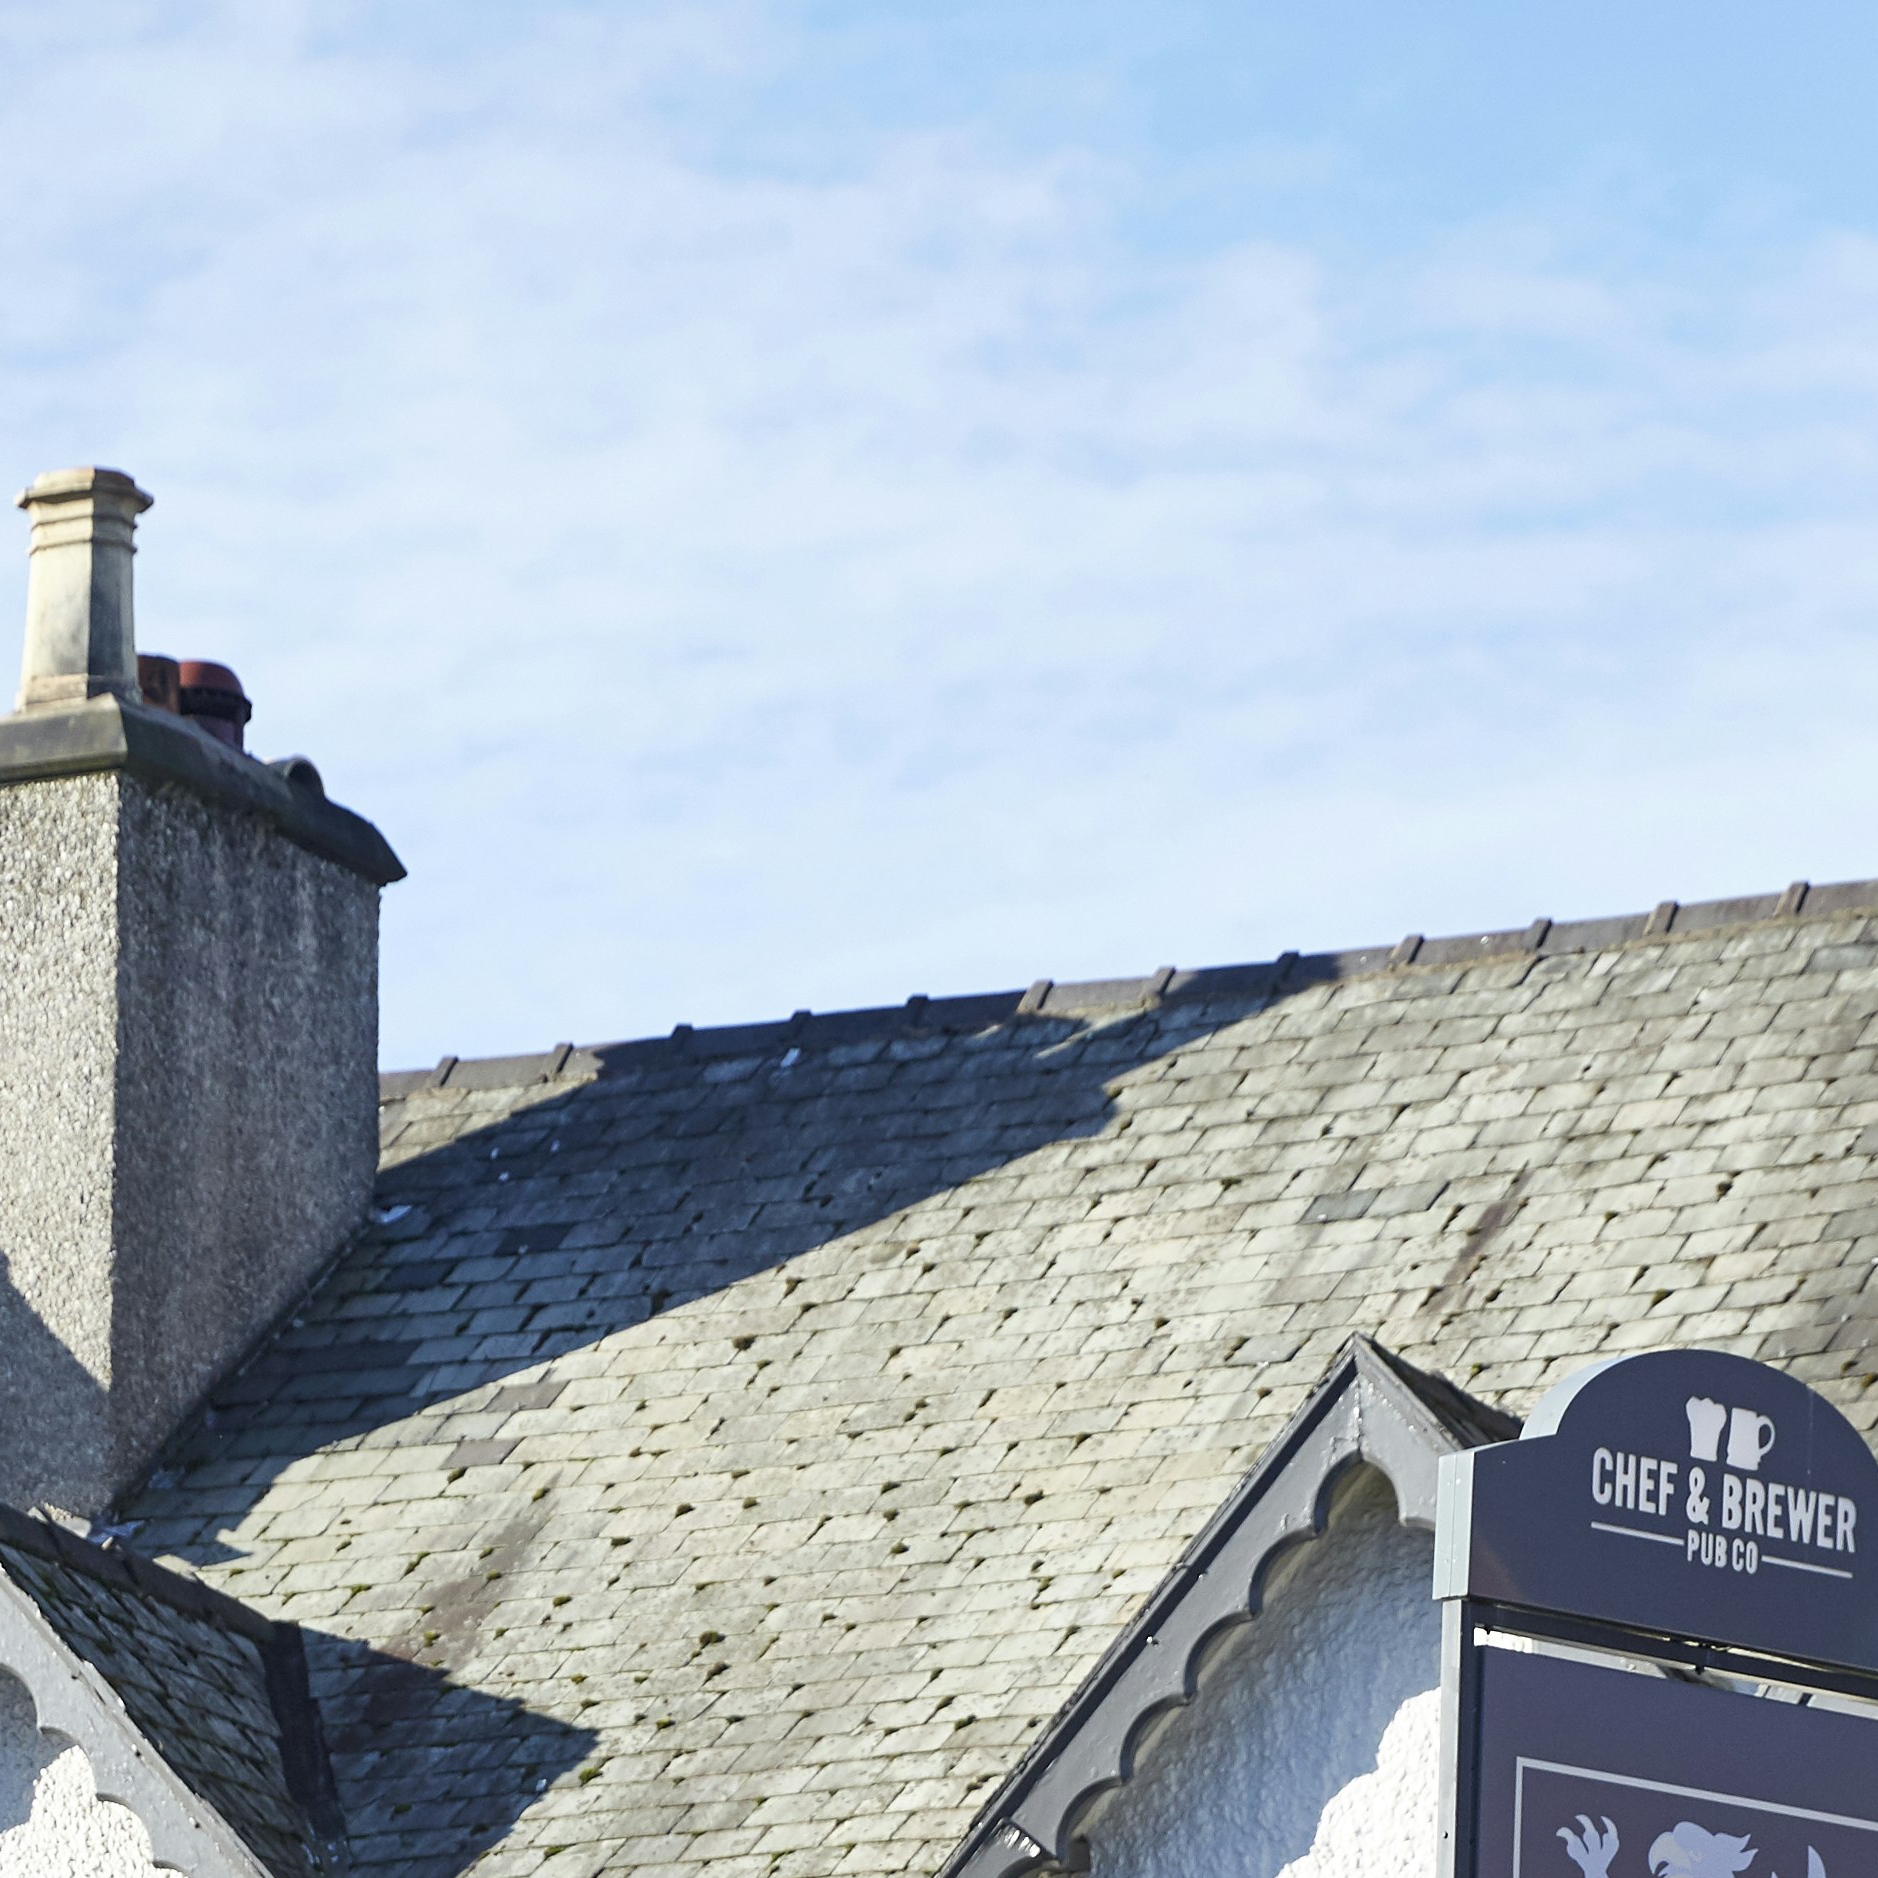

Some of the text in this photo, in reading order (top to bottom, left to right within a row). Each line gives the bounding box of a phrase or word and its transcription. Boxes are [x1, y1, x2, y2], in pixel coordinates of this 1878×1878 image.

[1591, 1446, 1857, 1554] CHEF & BREWER
[1686, 1529, 1759, 1575] PUB CO
